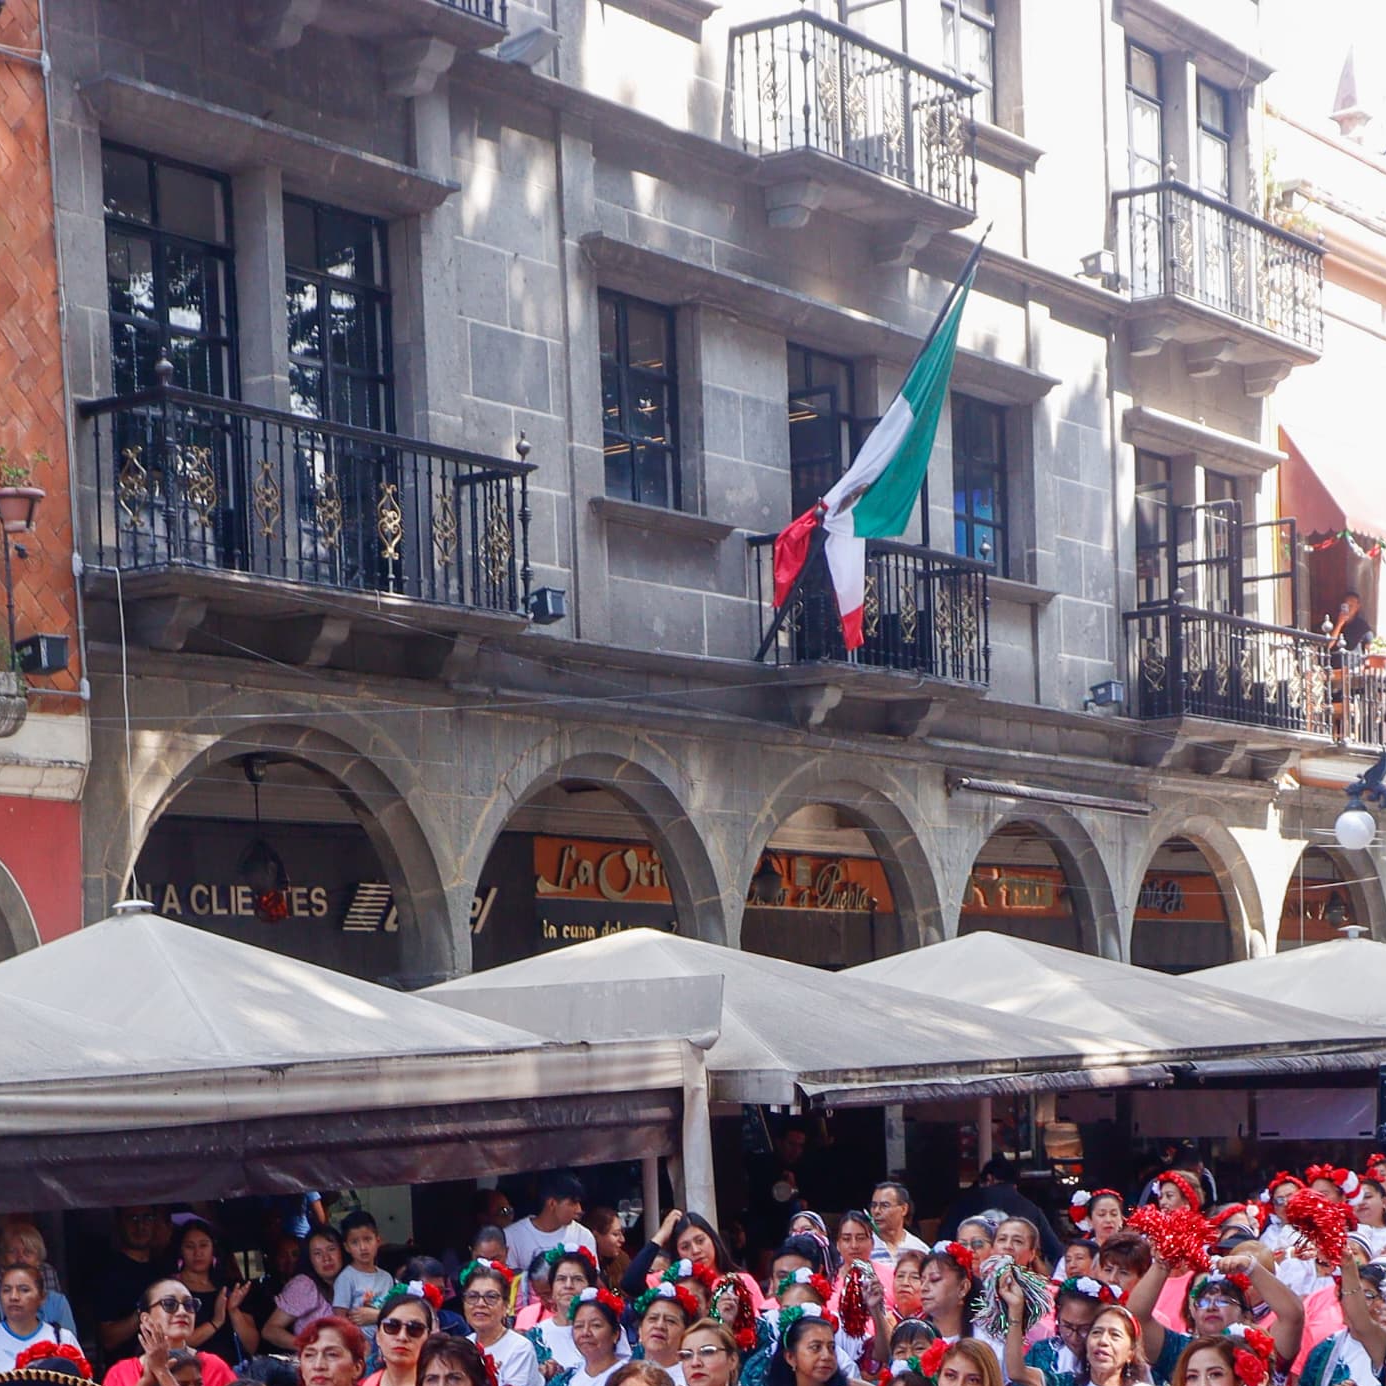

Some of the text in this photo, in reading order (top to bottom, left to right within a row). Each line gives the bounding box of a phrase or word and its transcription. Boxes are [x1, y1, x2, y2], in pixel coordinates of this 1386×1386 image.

[162, 883, 183, 914] A
[190, 884, 329, 918] CLIETES
[543, 919, 557, 939] la
